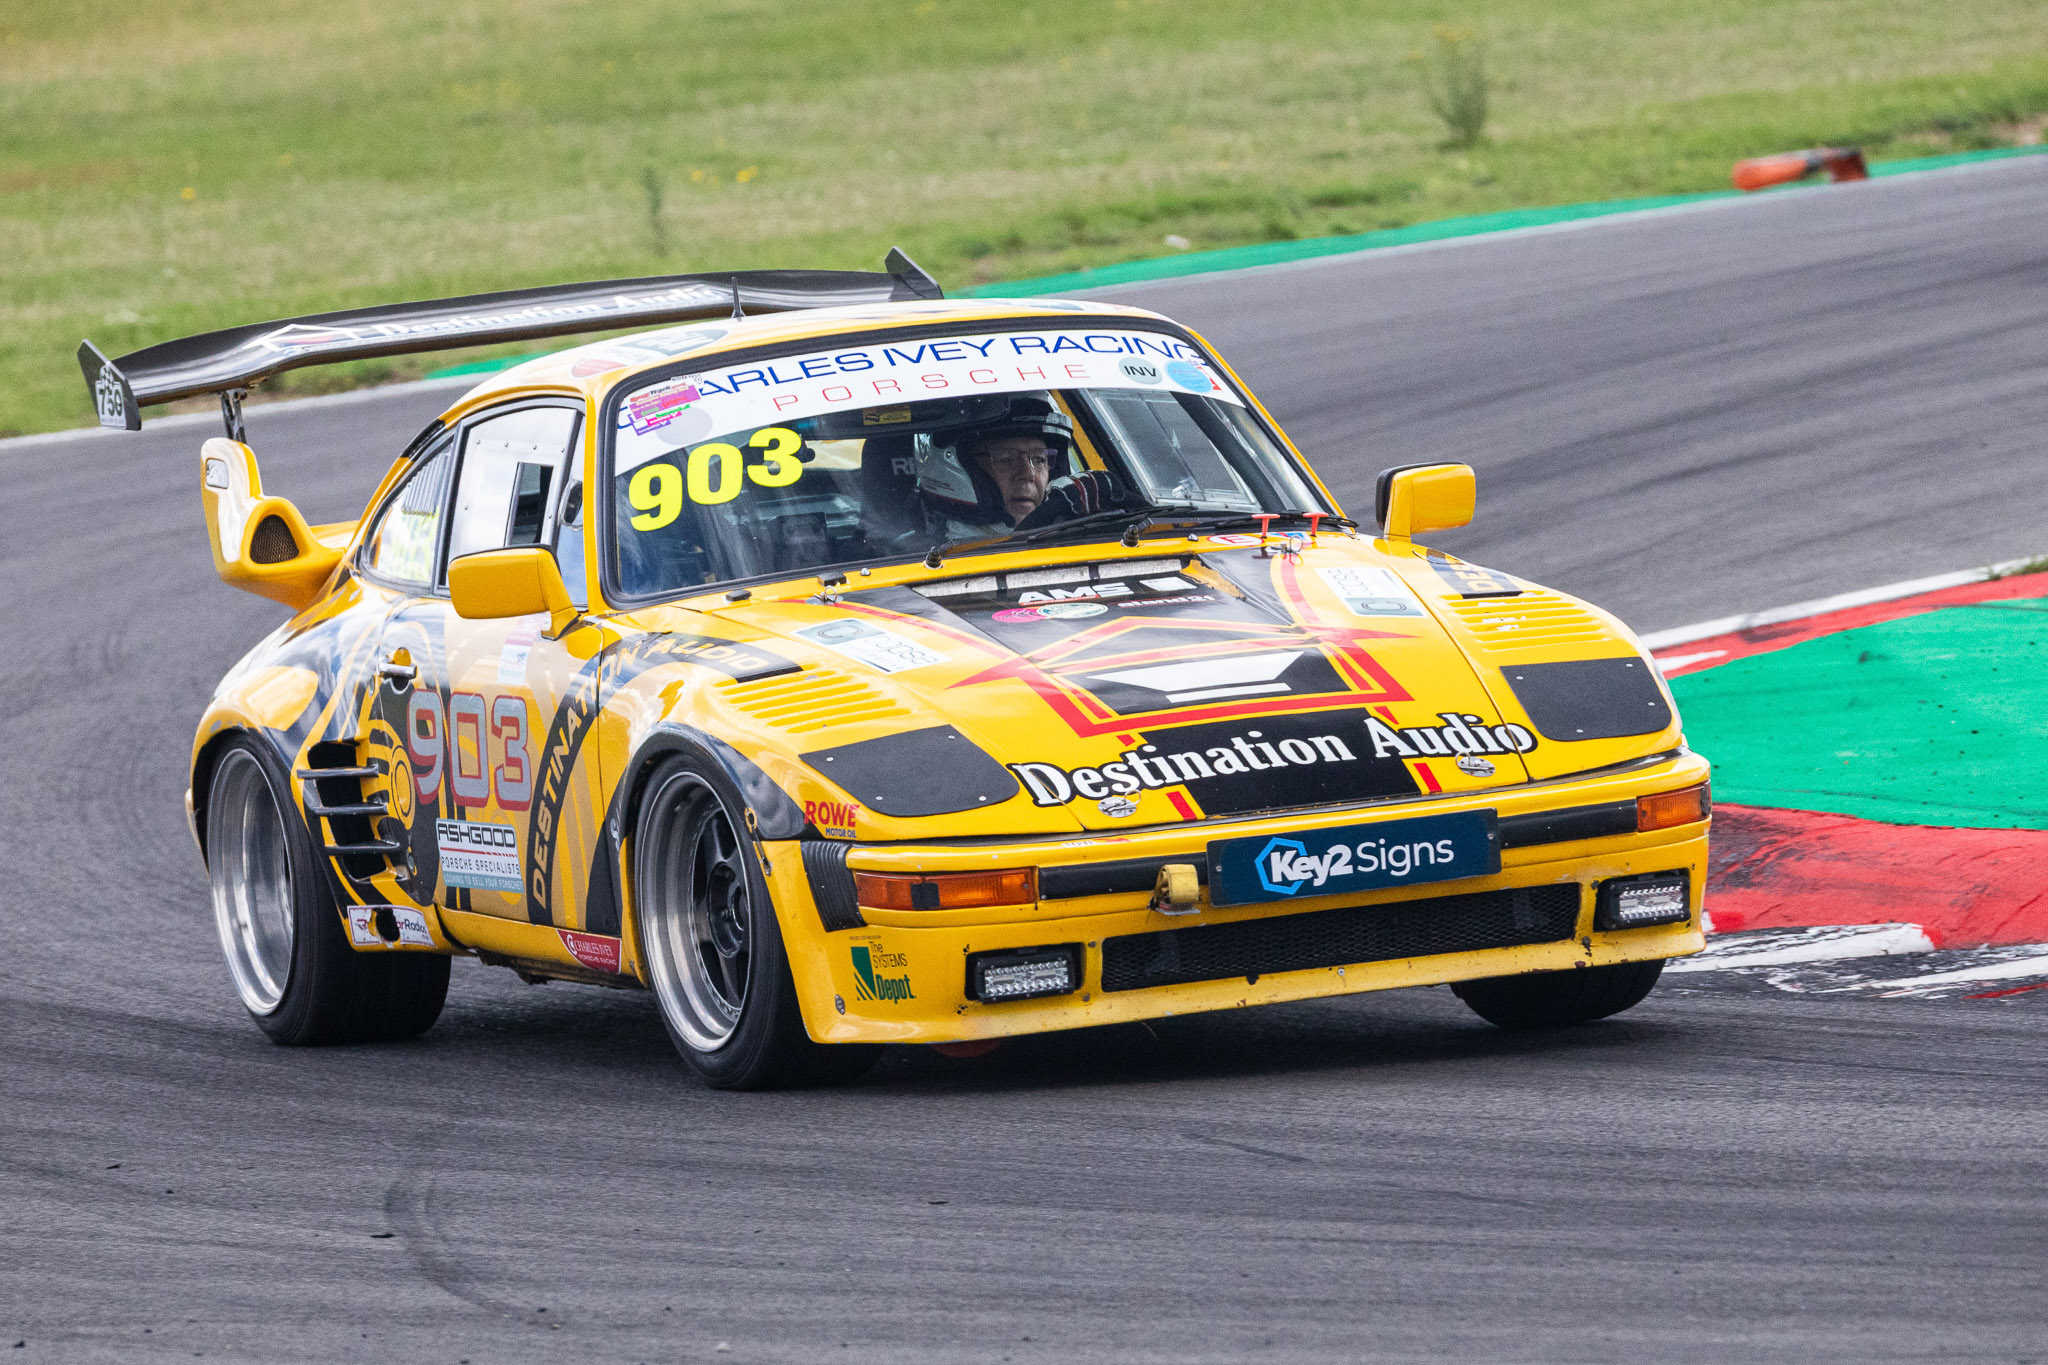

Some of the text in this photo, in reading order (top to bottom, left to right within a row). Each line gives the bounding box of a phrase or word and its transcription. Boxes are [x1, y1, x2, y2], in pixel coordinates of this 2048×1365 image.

[371, 303, 599, 335] Destination
[882, 338, 996, 367] IVEY
[1124, 365, 1156, 377] INV
[773, 364, 1091, 411] PORSCHE
[628, 427, 803, 532] 903
[1018, 582, 1134, 604] AMS
[407, 688, 532, 812] 903
[1013, 712, 1532, 806] Destination Audio
[533, 638, 769, 909] DESTINATION AUDIO
[804, 800, 860, 827] ROWE
[437, 823, 516, 848] ASHGOOD
[825, 827, 857, 838] MOTOR OIL
[441, 856, 520, 875] PORSCHE SPECIALISTS
[472, 876, 485, 886] SELL
[485, 878, 498, 888] YOUR
[868, 941, 883, 953] The
[872, 953, 908, 969] SYSTEMS
